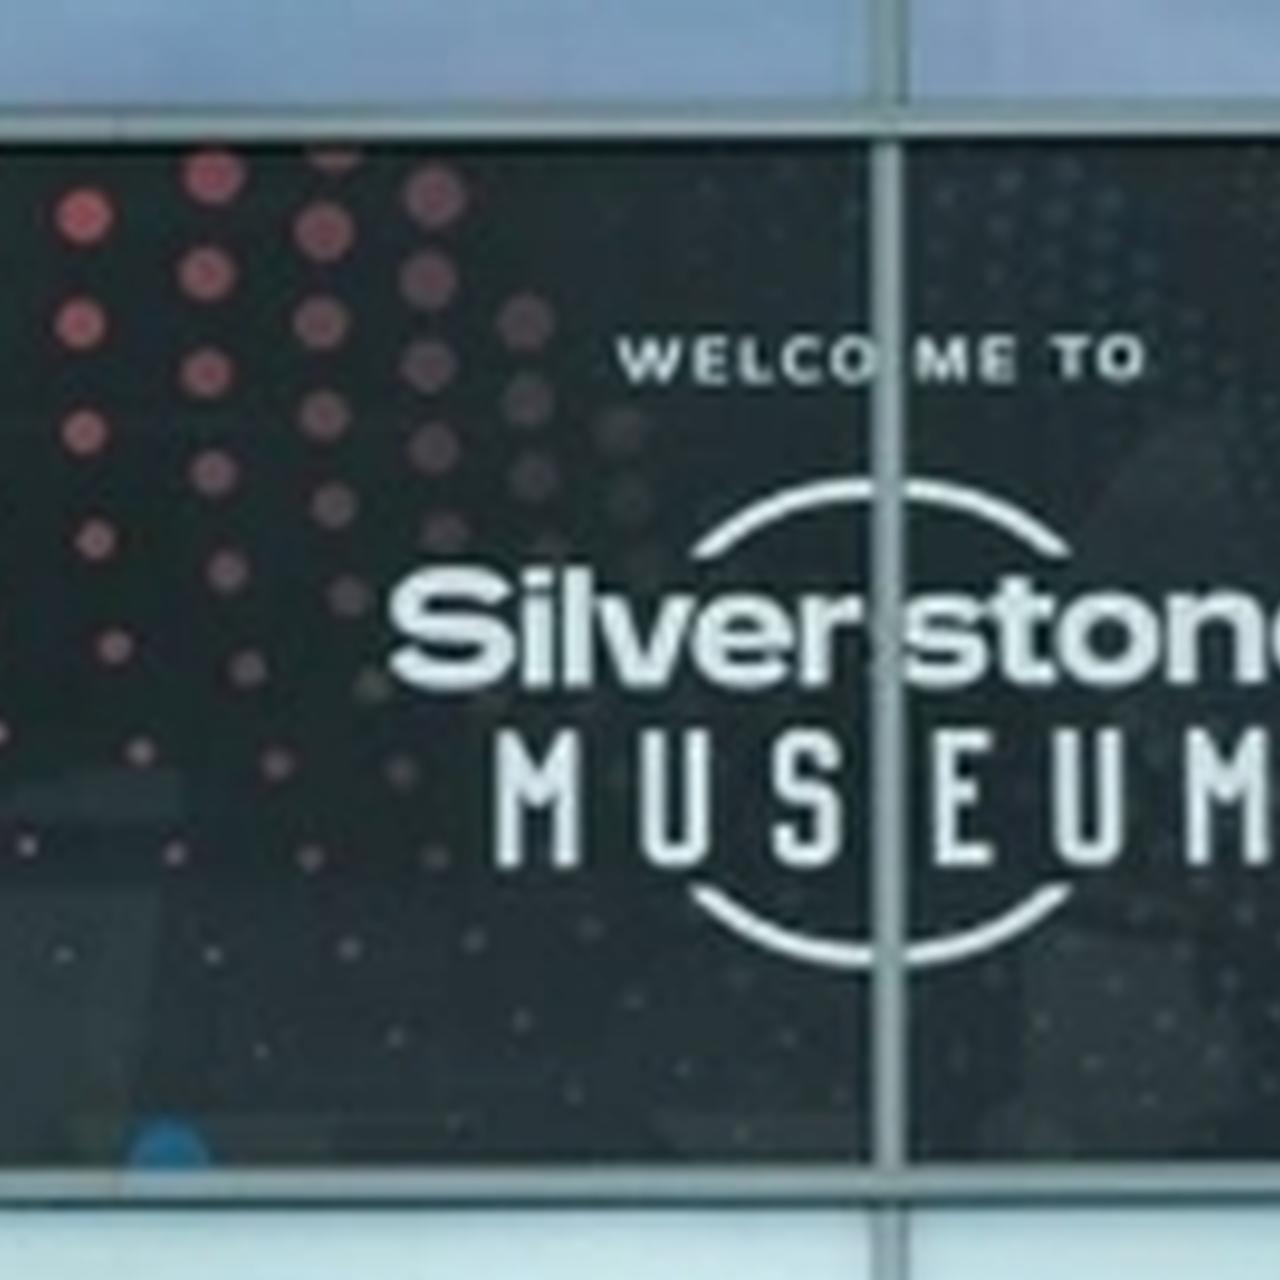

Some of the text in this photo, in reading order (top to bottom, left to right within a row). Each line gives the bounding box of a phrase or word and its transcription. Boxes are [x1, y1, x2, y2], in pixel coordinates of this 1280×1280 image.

[616, 333, 1147, 385] WELCOME TO
[493, 726, 1271, 870] MUSEUM
